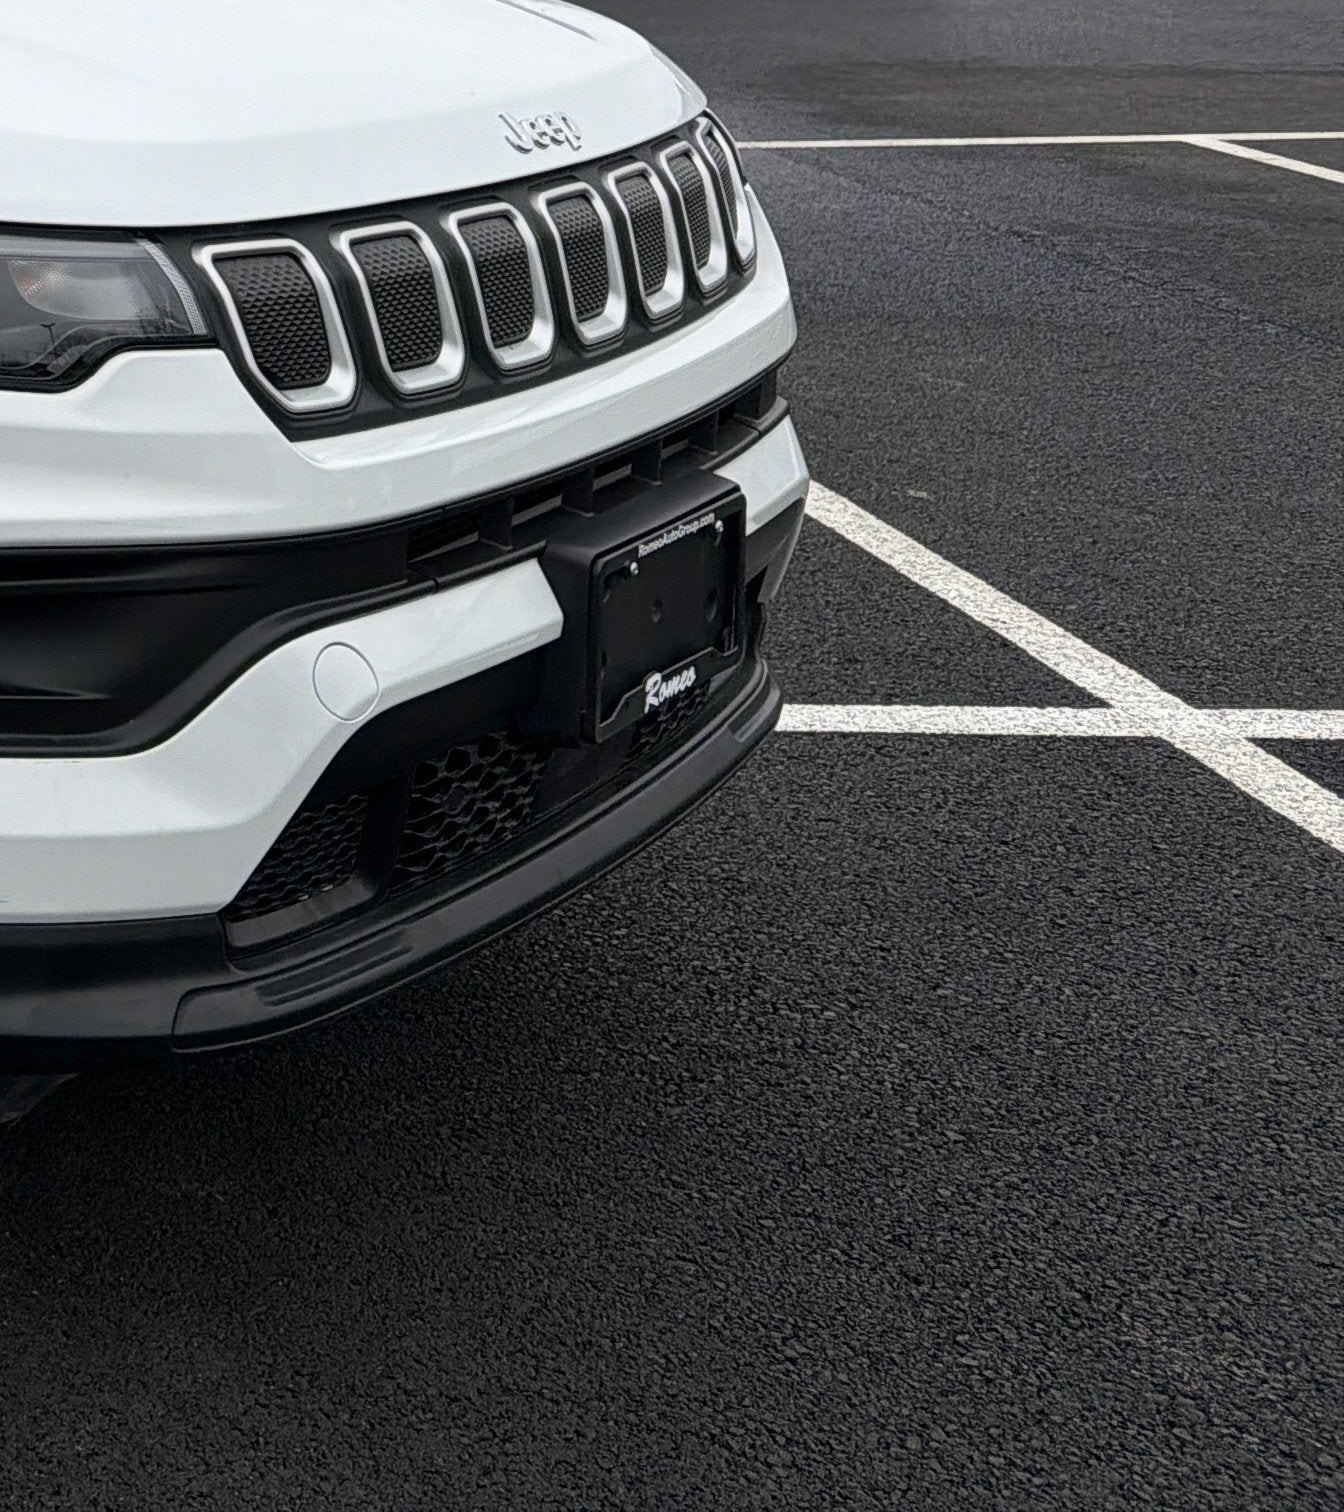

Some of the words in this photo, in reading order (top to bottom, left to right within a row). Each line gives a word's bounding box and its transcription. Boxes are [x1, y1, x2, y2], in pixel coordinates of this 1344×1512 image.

[498, 110, 582, 155] Jeep
[637, 512, 716, 558] RomeoAutoGroup.com
[643, 665, 698, 715] Romeo
